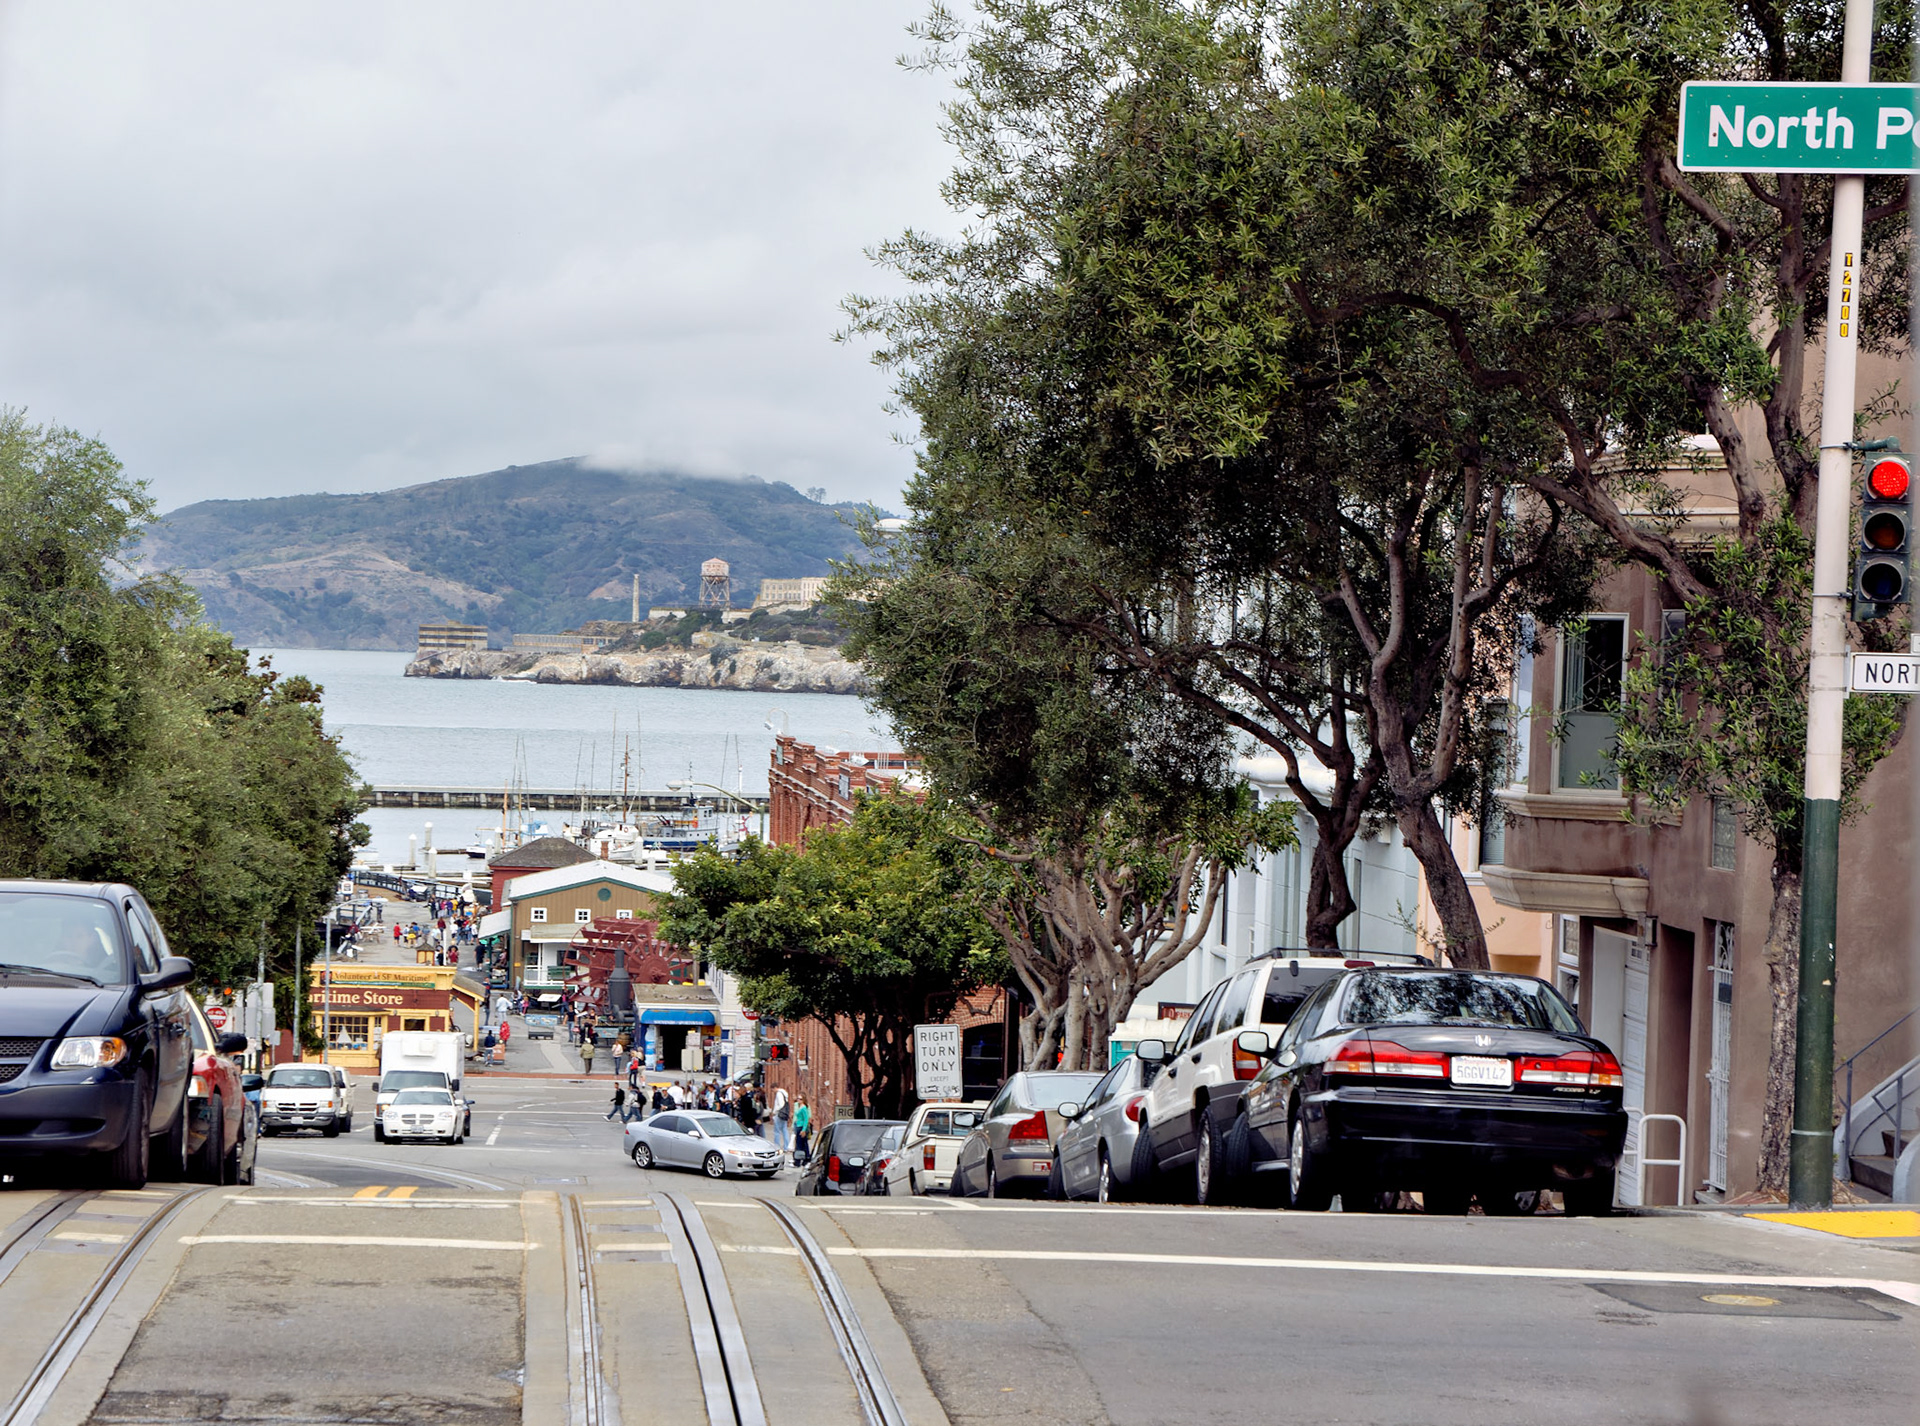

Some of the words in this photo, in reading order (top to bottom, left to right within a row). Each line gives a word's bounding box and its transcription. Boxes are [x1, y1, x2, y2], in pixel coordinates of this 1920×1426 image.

[1708, 104, 1854, 149] North
[1840, 252, 1853, 337] T2700
[1865, 662, 1920, 684] NORT
[335, 972, 372, 980] Volunteer
[306, 990, 360, 1004] aritime
[363, 990, 403, 1005] Store
[920, 1031, 954, 1041] RIGHT
[921, 1046, 956, 1057] TURN
[922, 1061, 955, 1072] ONLY
[838, 1108, 854, 1117] RIG
